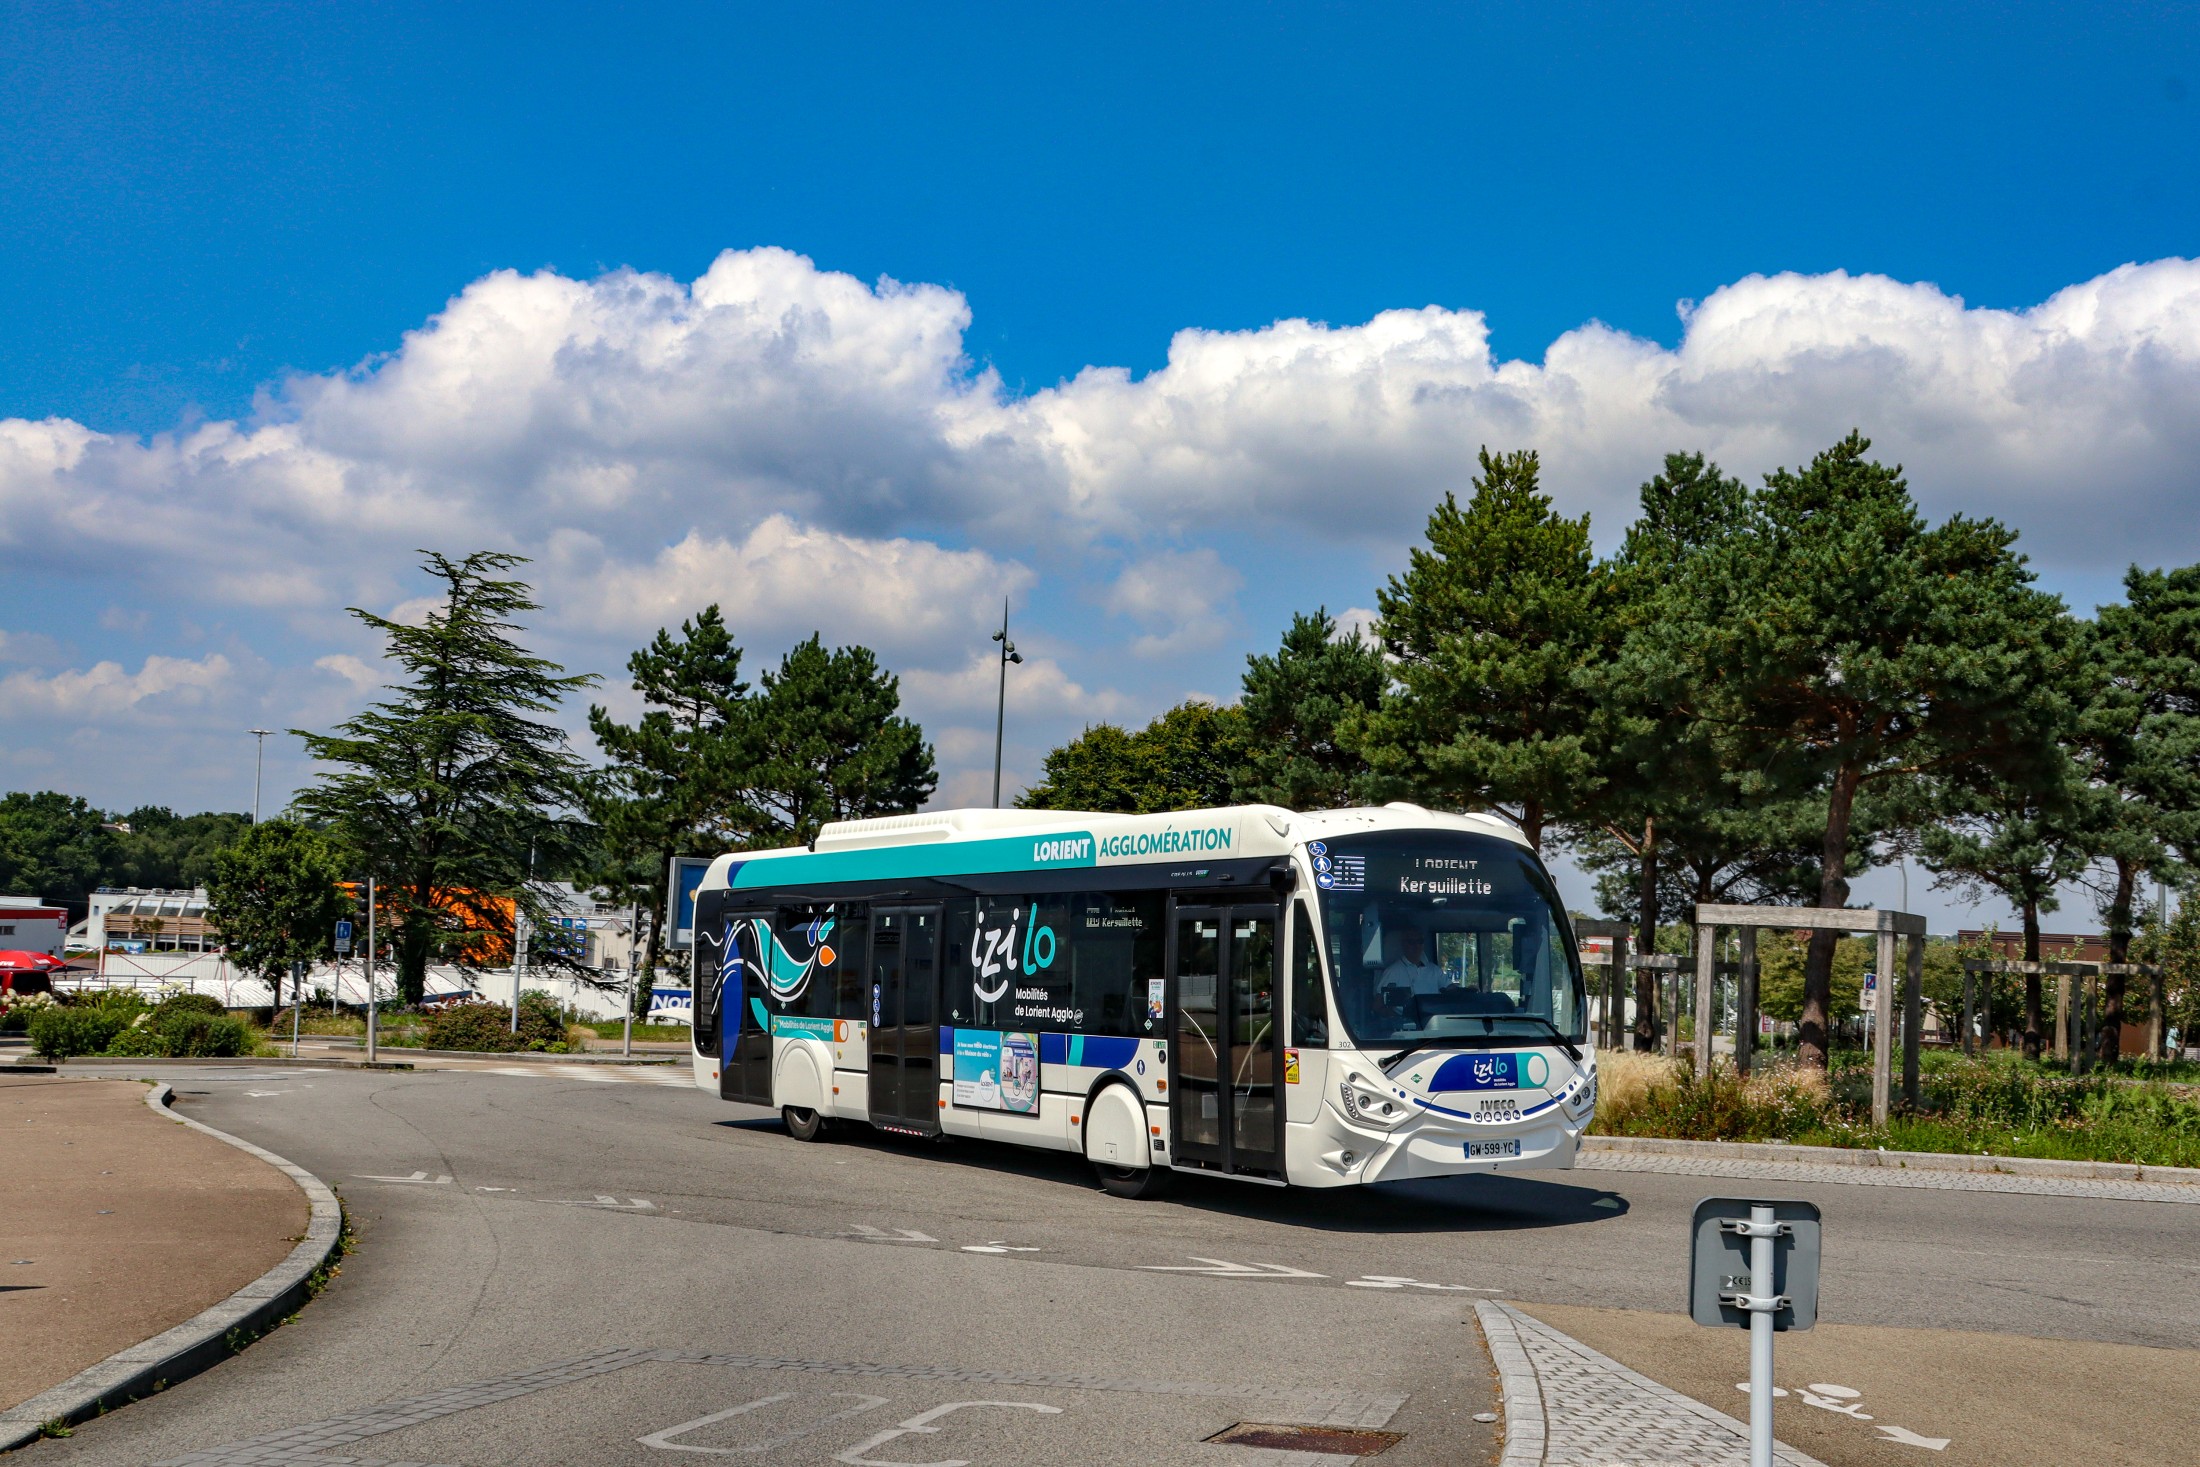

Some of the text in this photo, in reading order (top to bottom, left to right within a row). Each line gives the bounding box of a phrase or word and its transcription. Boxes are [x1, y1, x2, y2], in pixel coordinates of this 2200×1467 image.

[1033, 824, 1232, 862] LORIENT AGGLOMÉRATION
[1015, 987, 1049, 1001] Mobilités
[1015, 1006, 1025, 1017] de
[1025, 1005, 1051, 1019] Lorient
[1051, 1007, 1074, 1023] Agglo
[1480, 1099, 1516, 1111] IVECO
[1470, 1142, 1514, 1156] GW-599-YC
